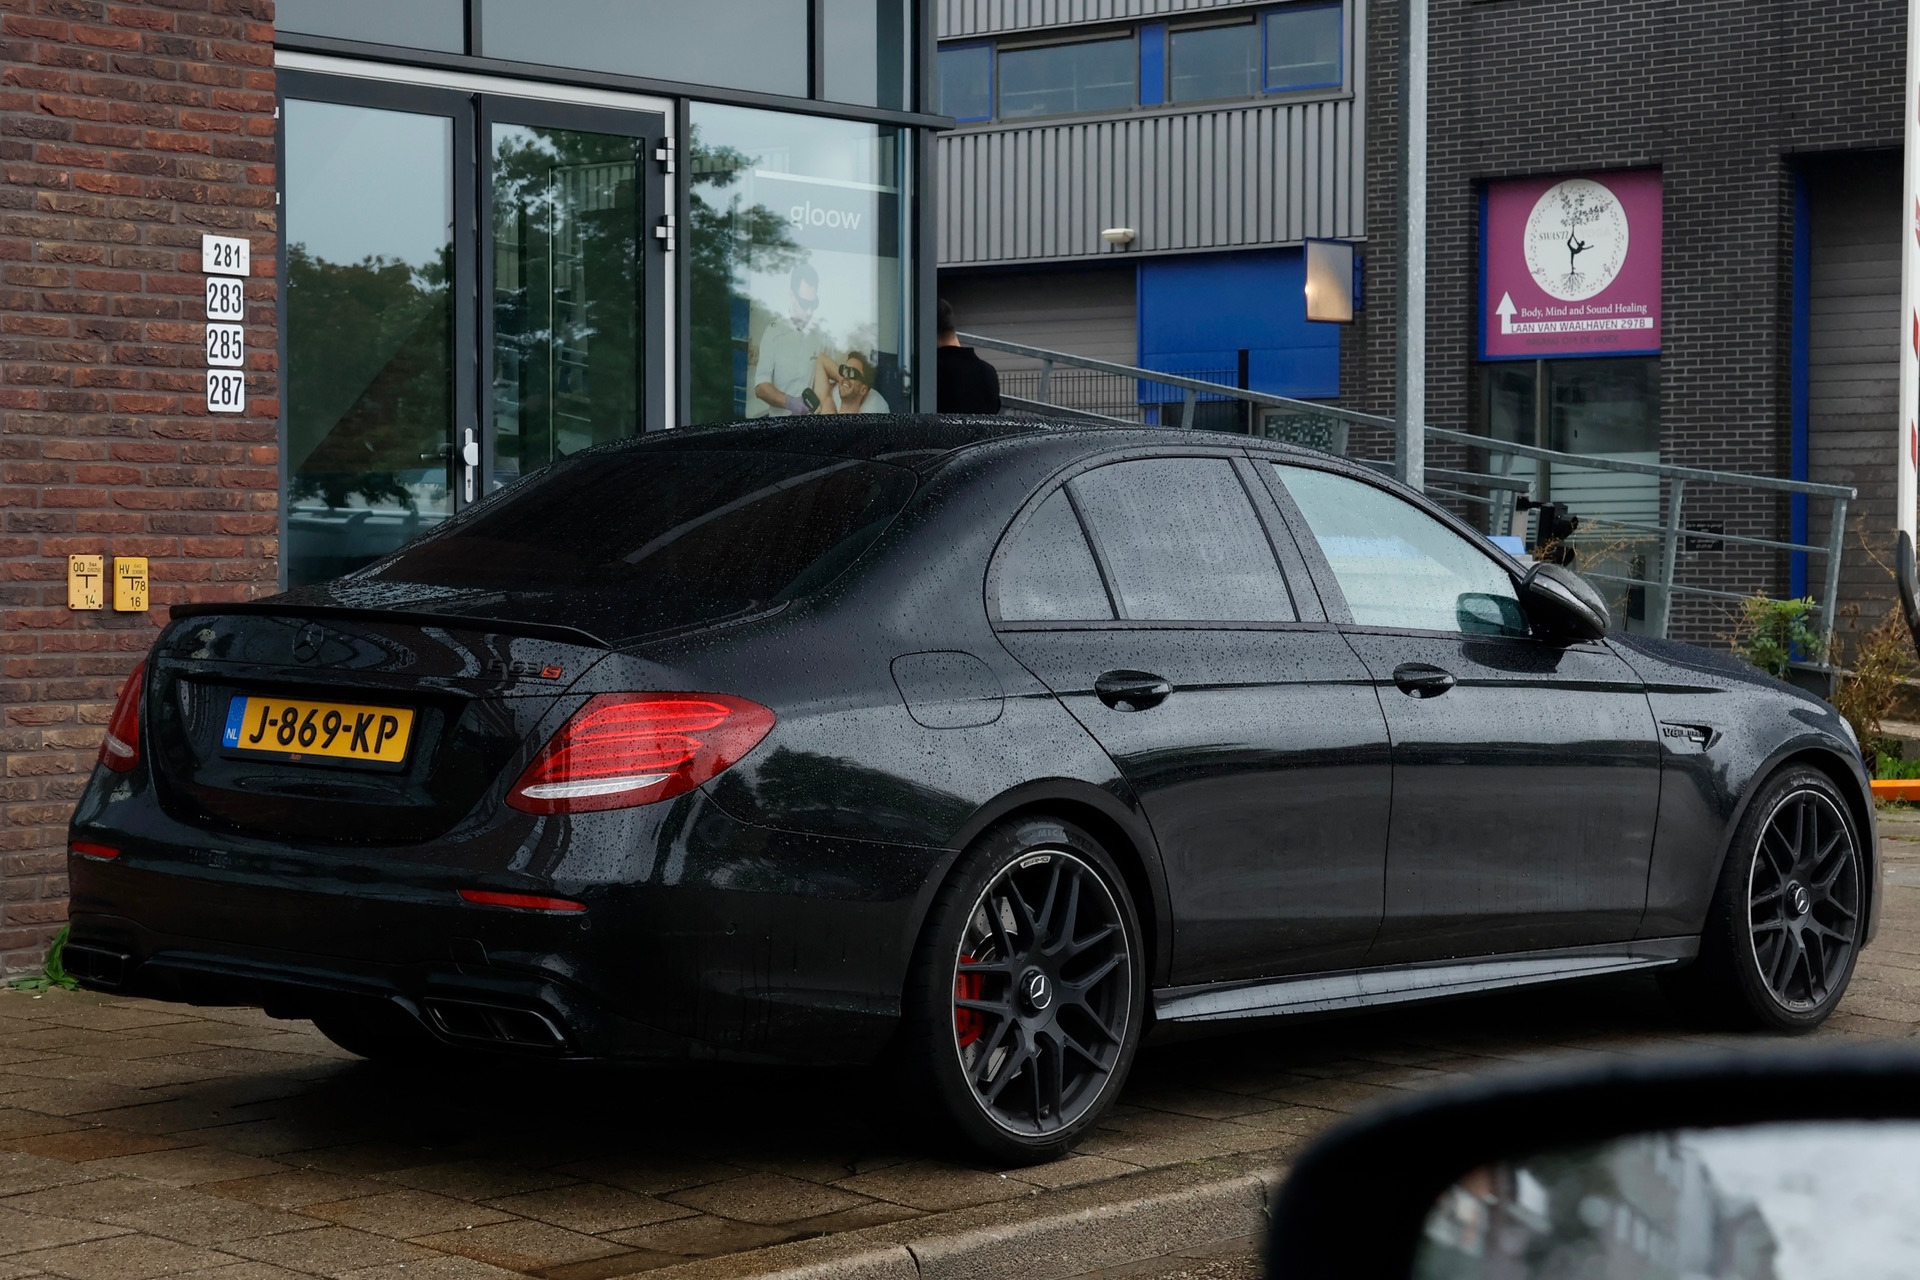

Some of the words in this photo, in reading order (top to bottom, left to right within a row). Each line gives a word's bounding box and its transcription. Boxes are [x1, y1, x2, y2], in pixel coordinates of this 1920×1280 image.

[790, 200, 861, 231] gloow
[213, 242, 241, 269] 281
[208, 282, 242, 314] 283
[1521, 308, 1544, 319] Body,
[1545, 306, 1568, 317] Mind
[1569, 305, 1585, 315] and
[1586, 304, 1614, 314] Sound
[1614, 302, 1648, 314] Healing
[1511, 323, 1535, 333] LAAN
[1538, 321, 1557, 332] VAN
[1560, 319, 1618, 331] WAALHAVEN
[208, 329, 242, 360] 285
[209, 375, 242, 405] 287
[119, 564, 130, 574] HV
[85, 595, 95, 605] 14
[131, 596, 141, 607] 16
[226, 728, 238, 740] NL
[249, 706, 399, 754] J-869-KP
